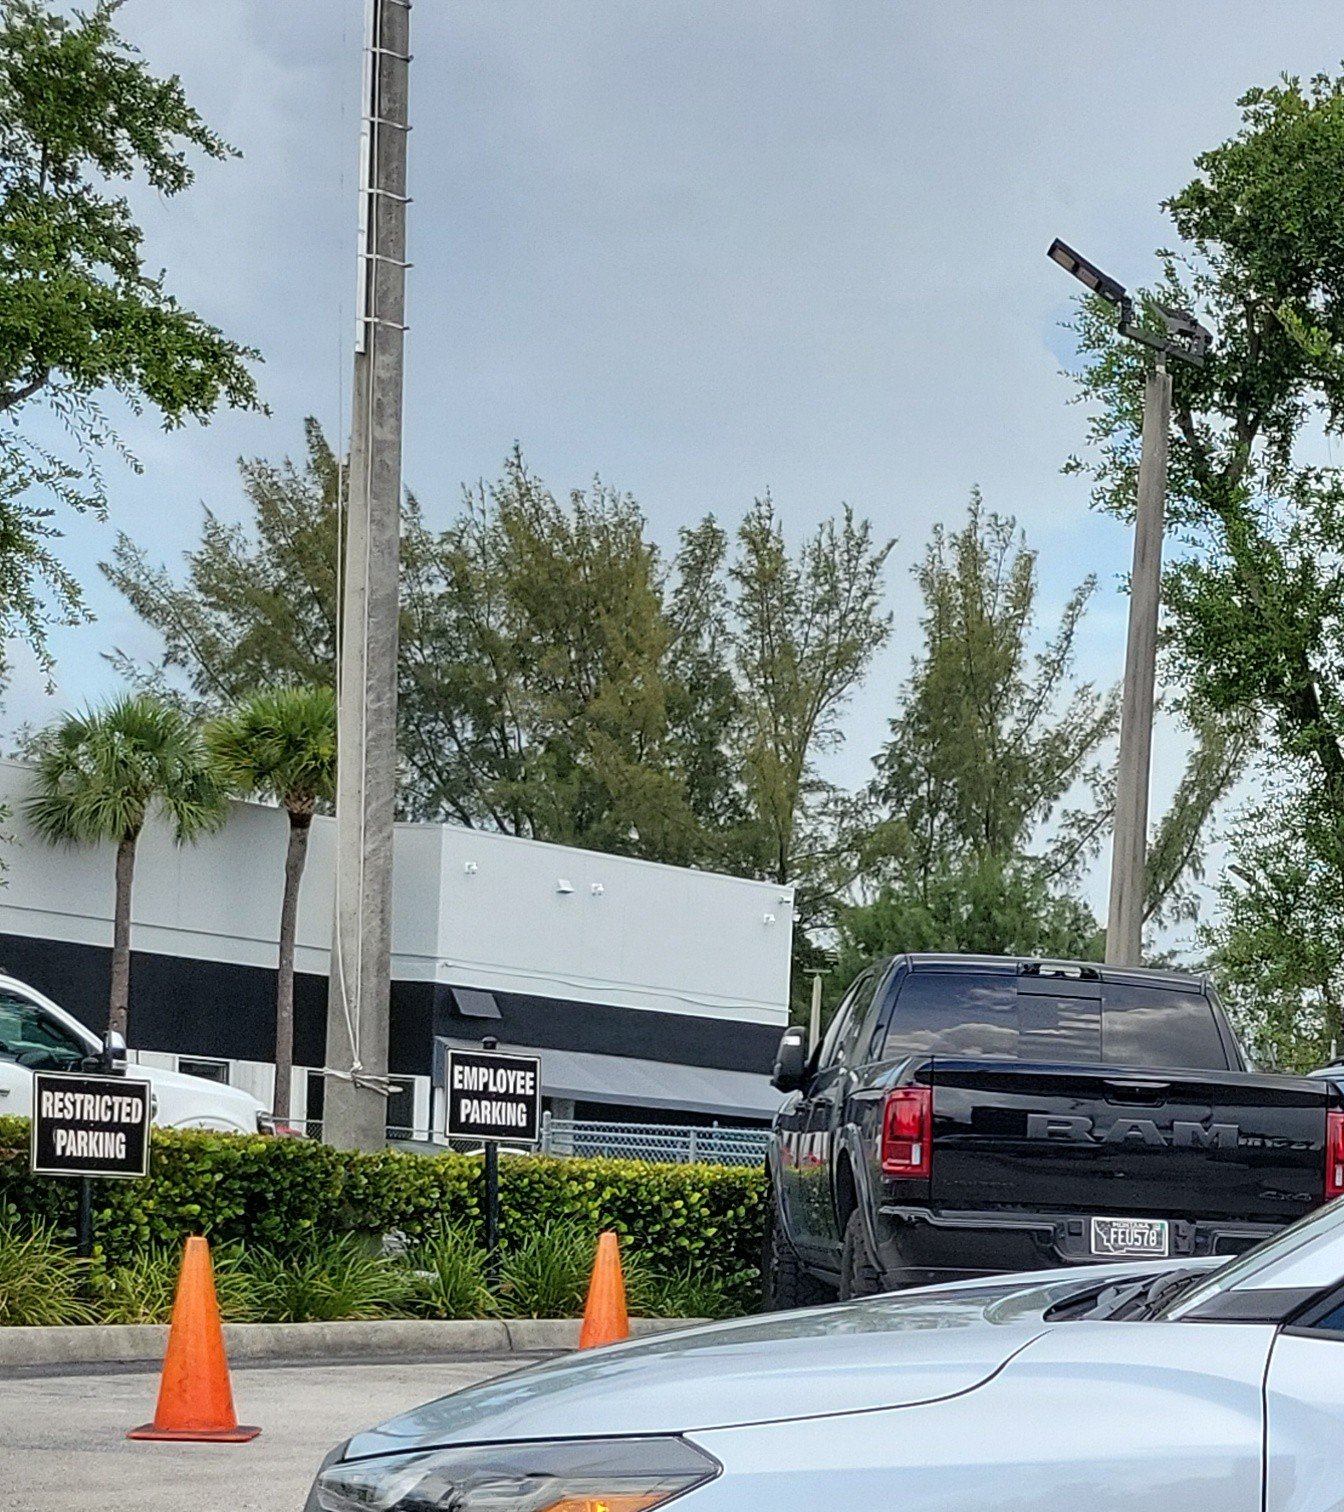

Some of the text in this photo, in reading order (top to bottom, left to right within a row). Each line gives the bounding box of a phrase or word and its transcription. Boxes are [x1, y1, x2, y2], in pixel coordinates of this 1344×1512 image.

[453, 1064, 535, 1096] EMPLOYEE
[41, 1090, 143, 1124] RESTRICTED
[460, 1098, 527, 1128] PARKING
[55, 1129, 126, 1160] PARKING
[1027, 1113, 1239, 1149] RAM
[1110, 1228, 1157, 1247] FEU578
